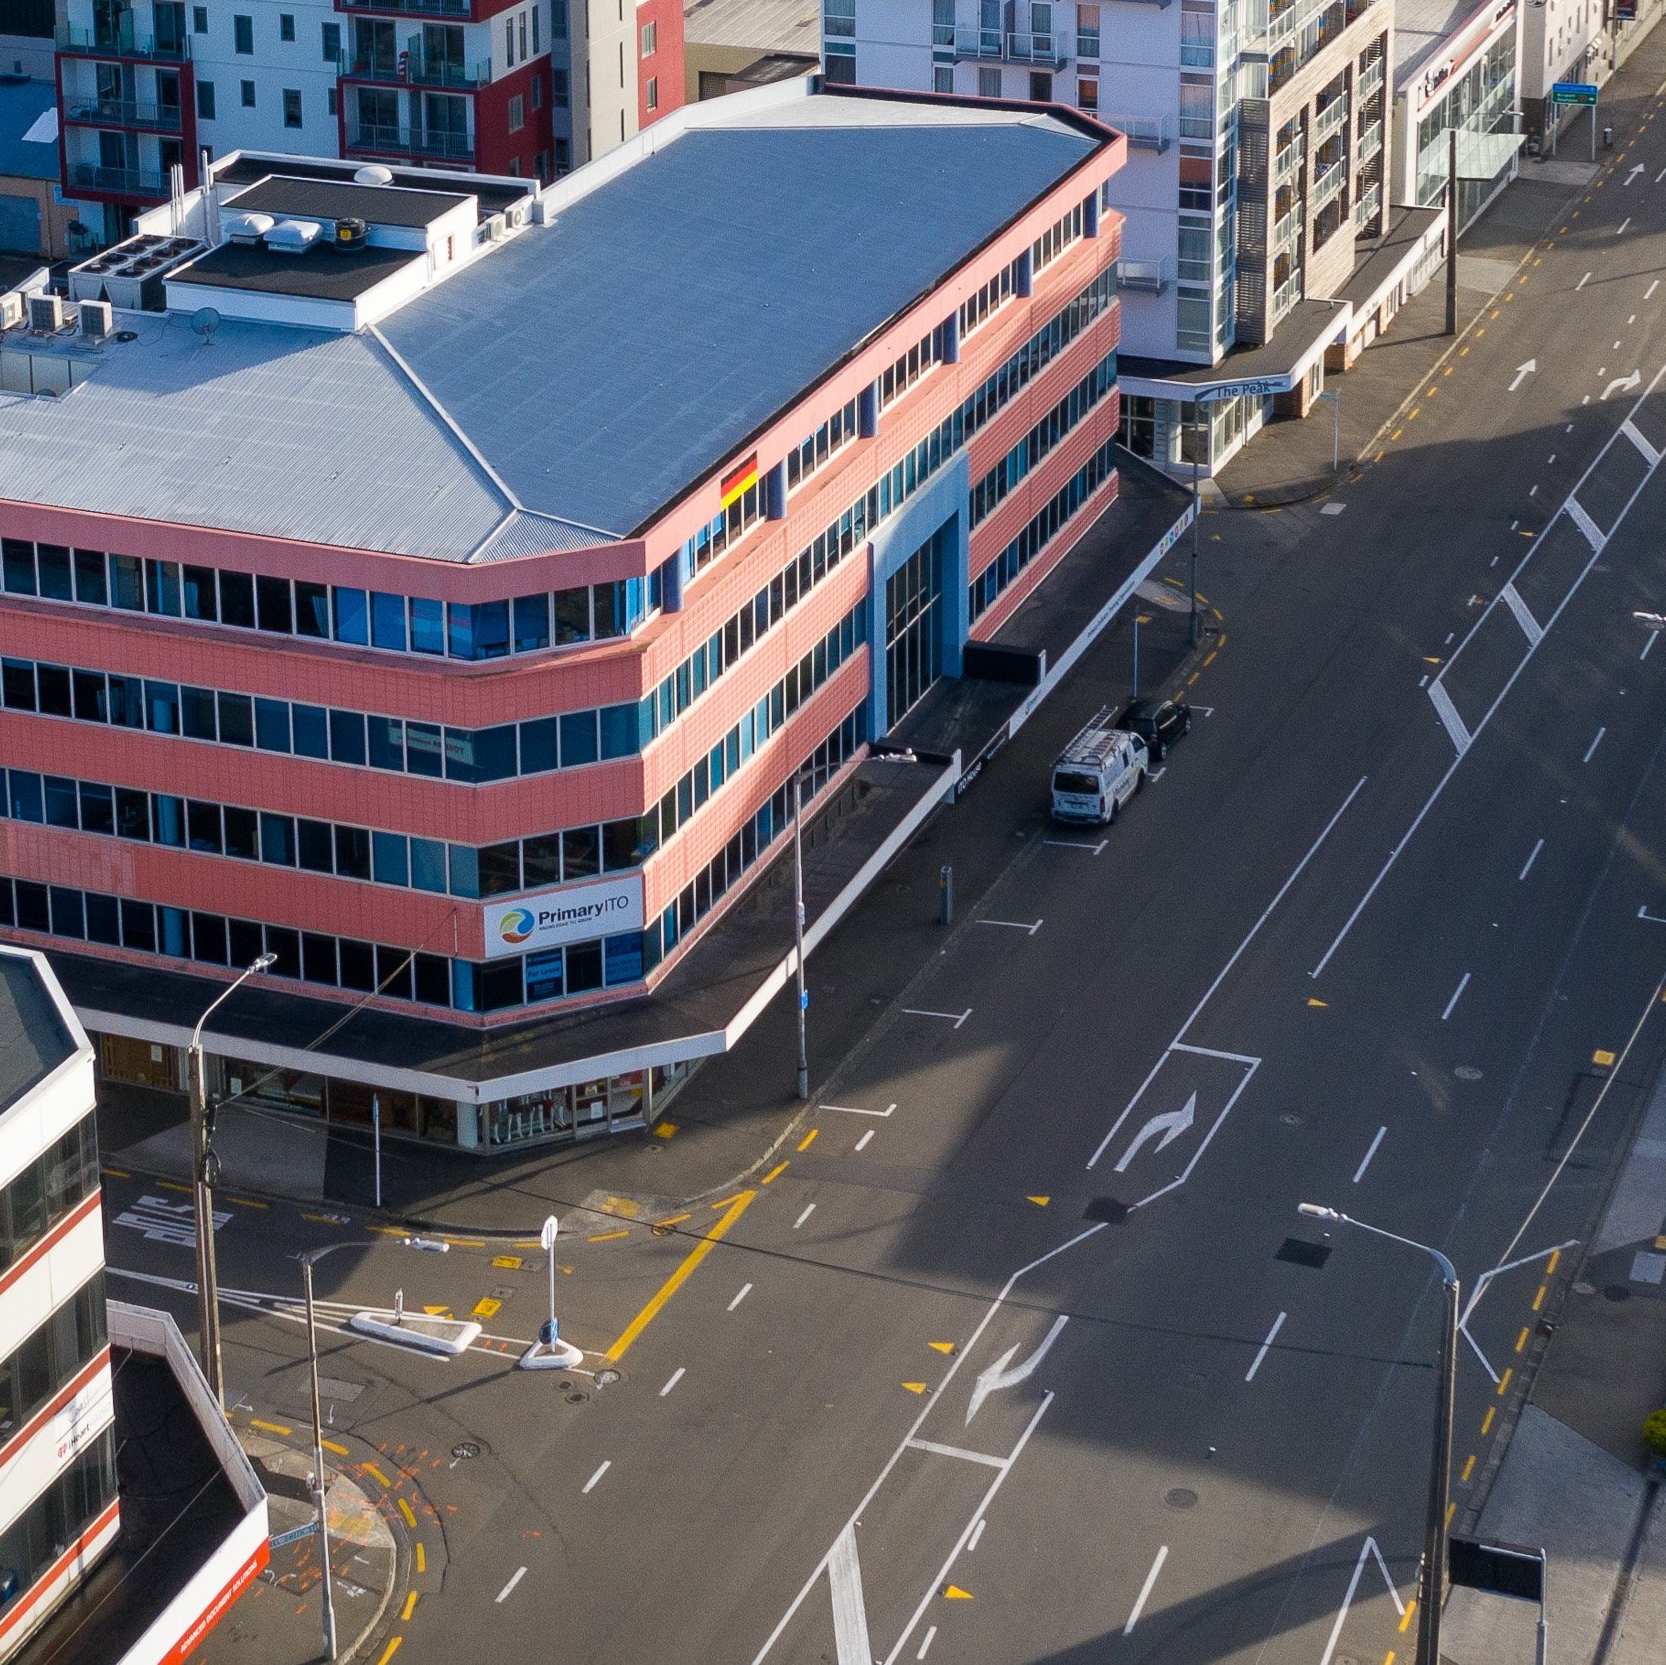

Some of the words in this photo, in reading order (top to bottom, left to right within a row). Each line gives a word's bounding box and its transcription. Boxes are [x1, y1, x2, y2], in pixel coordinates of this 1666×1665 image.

[1216, 385, 1238, 399] The
[1242, 383, 1270, 395] Peak
[180, 1619, 207, 1653] ADVANCED
[206, 1589, 232, 1623] DOCUMENT
[232, 1559, 258, 1593] SOLUTIONS
